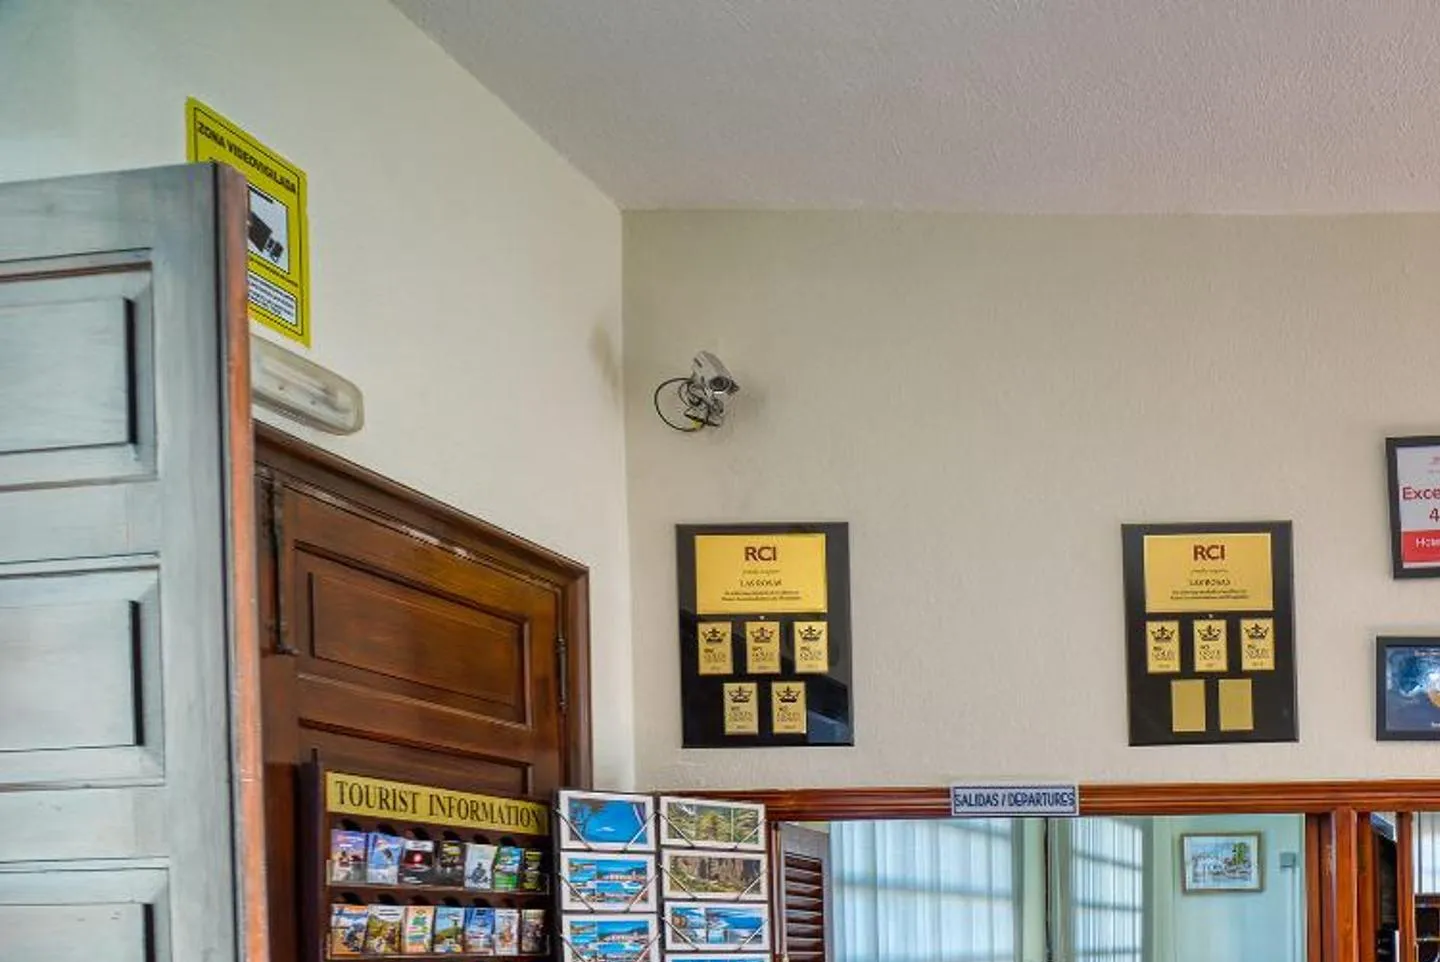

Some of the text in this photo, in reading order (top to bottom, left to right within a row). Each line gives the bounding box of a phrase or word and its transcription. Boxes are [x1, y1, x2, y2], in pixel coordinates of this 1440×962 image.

[198, 121, 297, 194] ZONA VIDEOVIGILADA
[744, 546, 777, 561] RCI
[1193, 544, 1225, 561] RCI
[335, 780, 542, 828] TOURIST INFORMATION
[954, 792, 999, 807] SALIDAS
[1008, 791, 1076, 807] DEPARTURES
